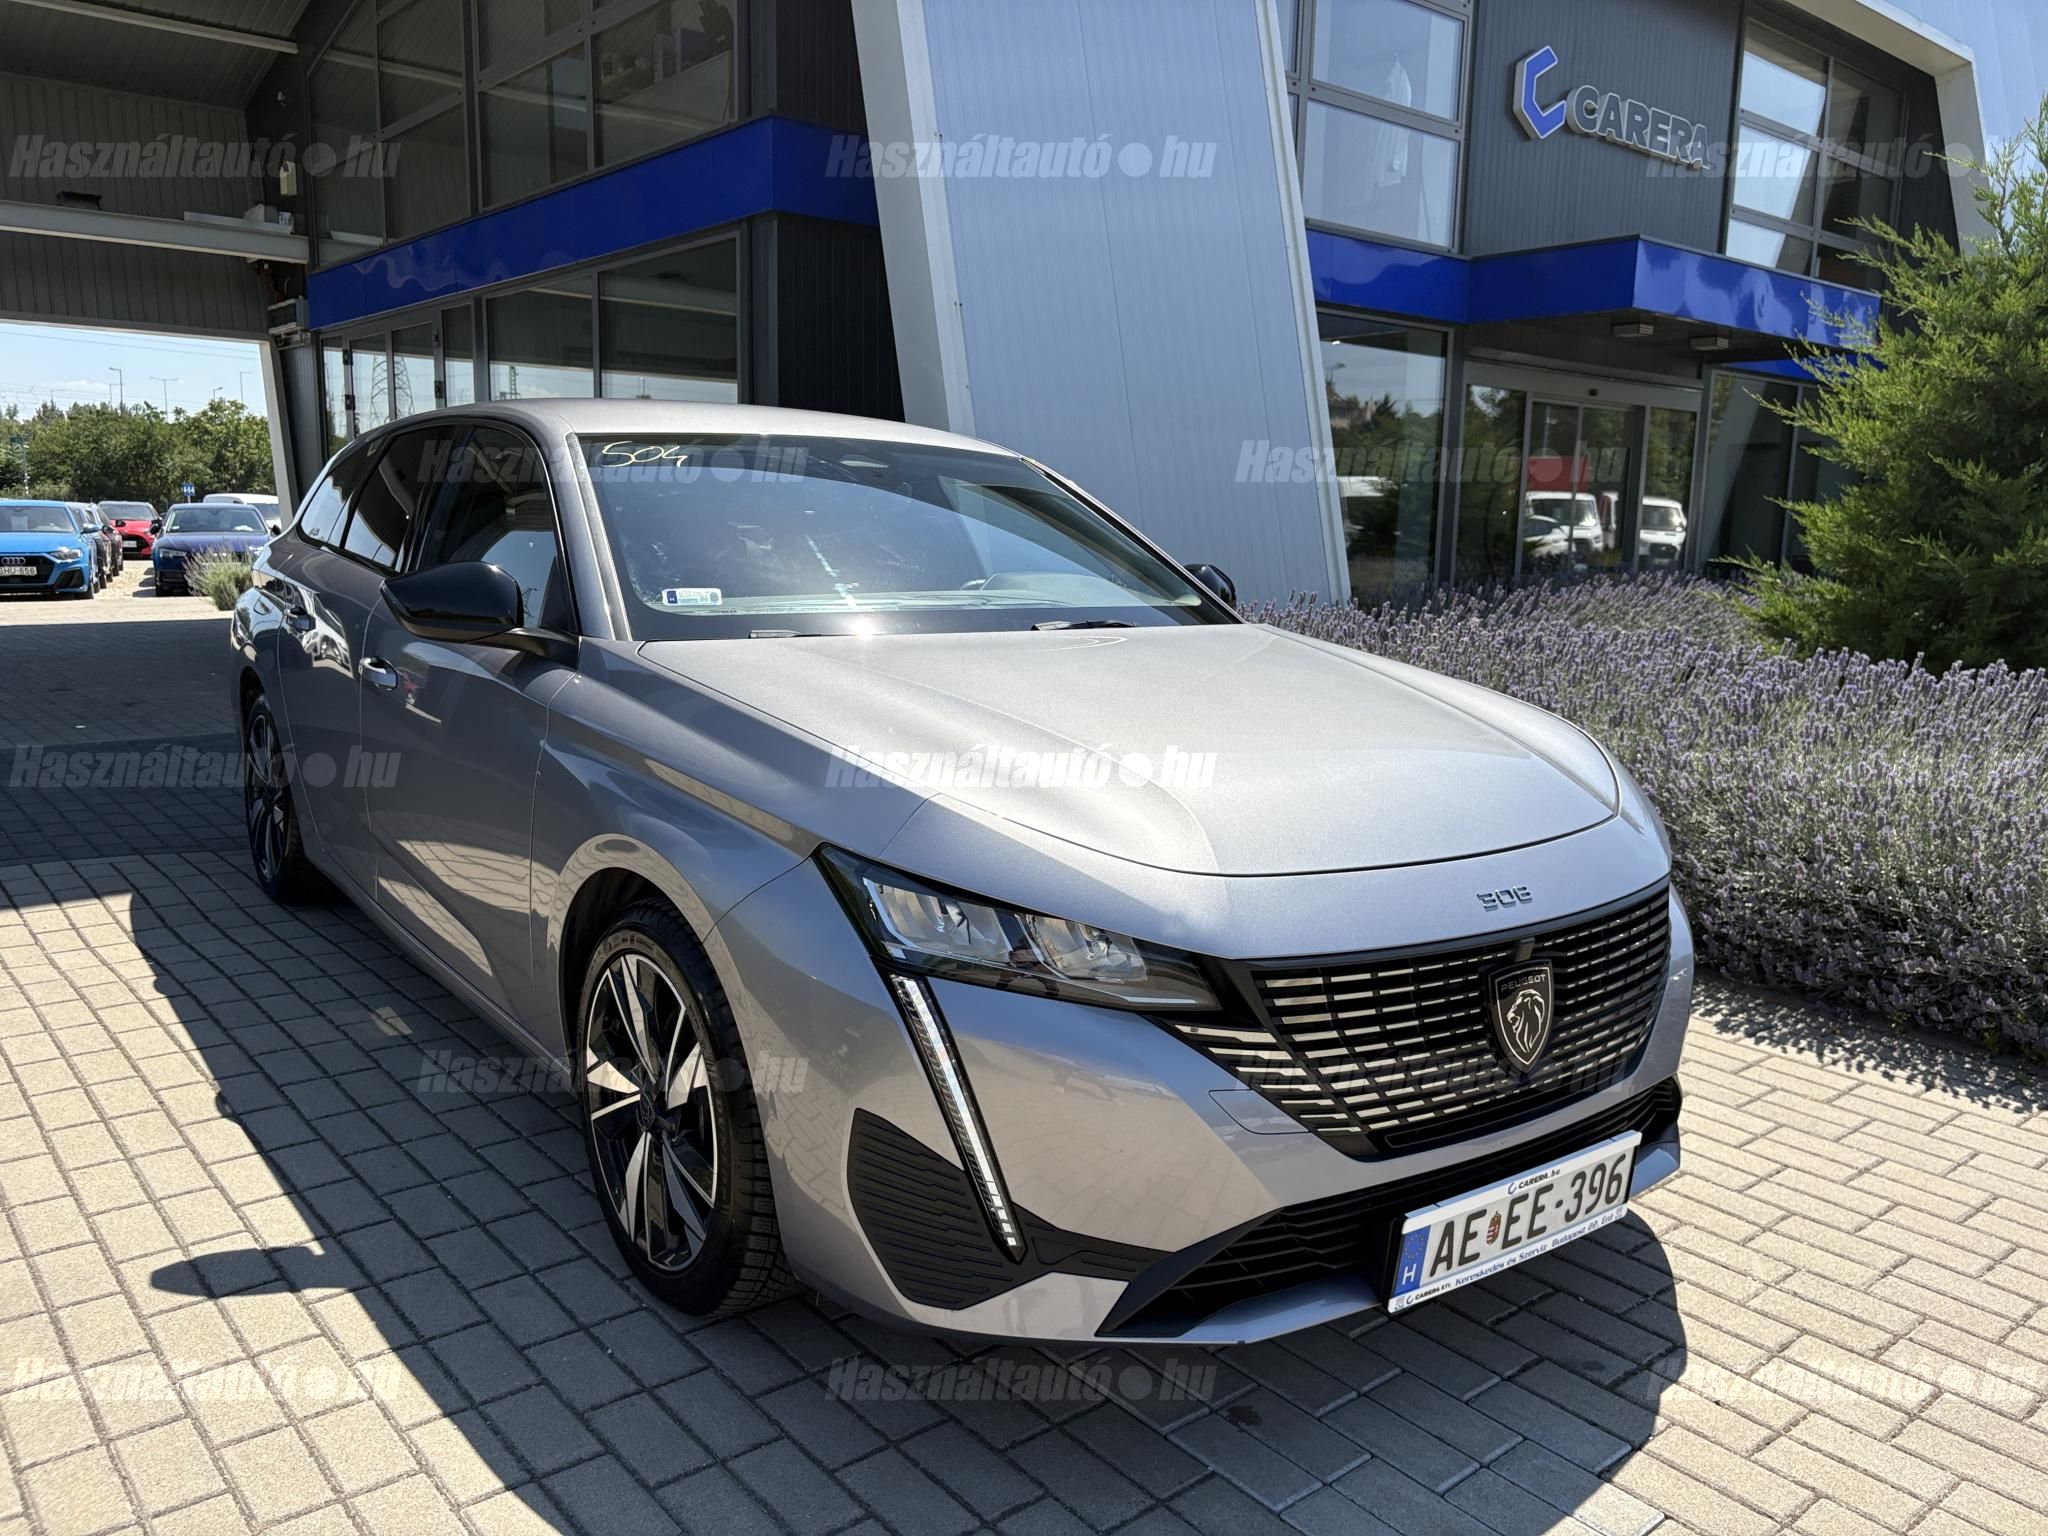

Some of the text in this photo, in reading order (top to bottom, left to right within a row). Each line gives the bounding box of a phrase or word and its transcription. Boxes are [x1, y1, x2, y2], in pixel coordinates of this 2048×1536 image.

[1570, 84, 1710, 170] CARERA
[1501, 973, 1546, 992] PEUGEOT
[1402, 1263, 1416, 1286] H
[1415, 1286, 1441, 1300] CARERA
[1455, 1261, 1505, 1286] Kereskedés
[1506, 1255, 1517, 1266] és
[1518, 1244, 1548, 1261] Szerviz
[1552, 1226, 1586, 1248] Budapest
